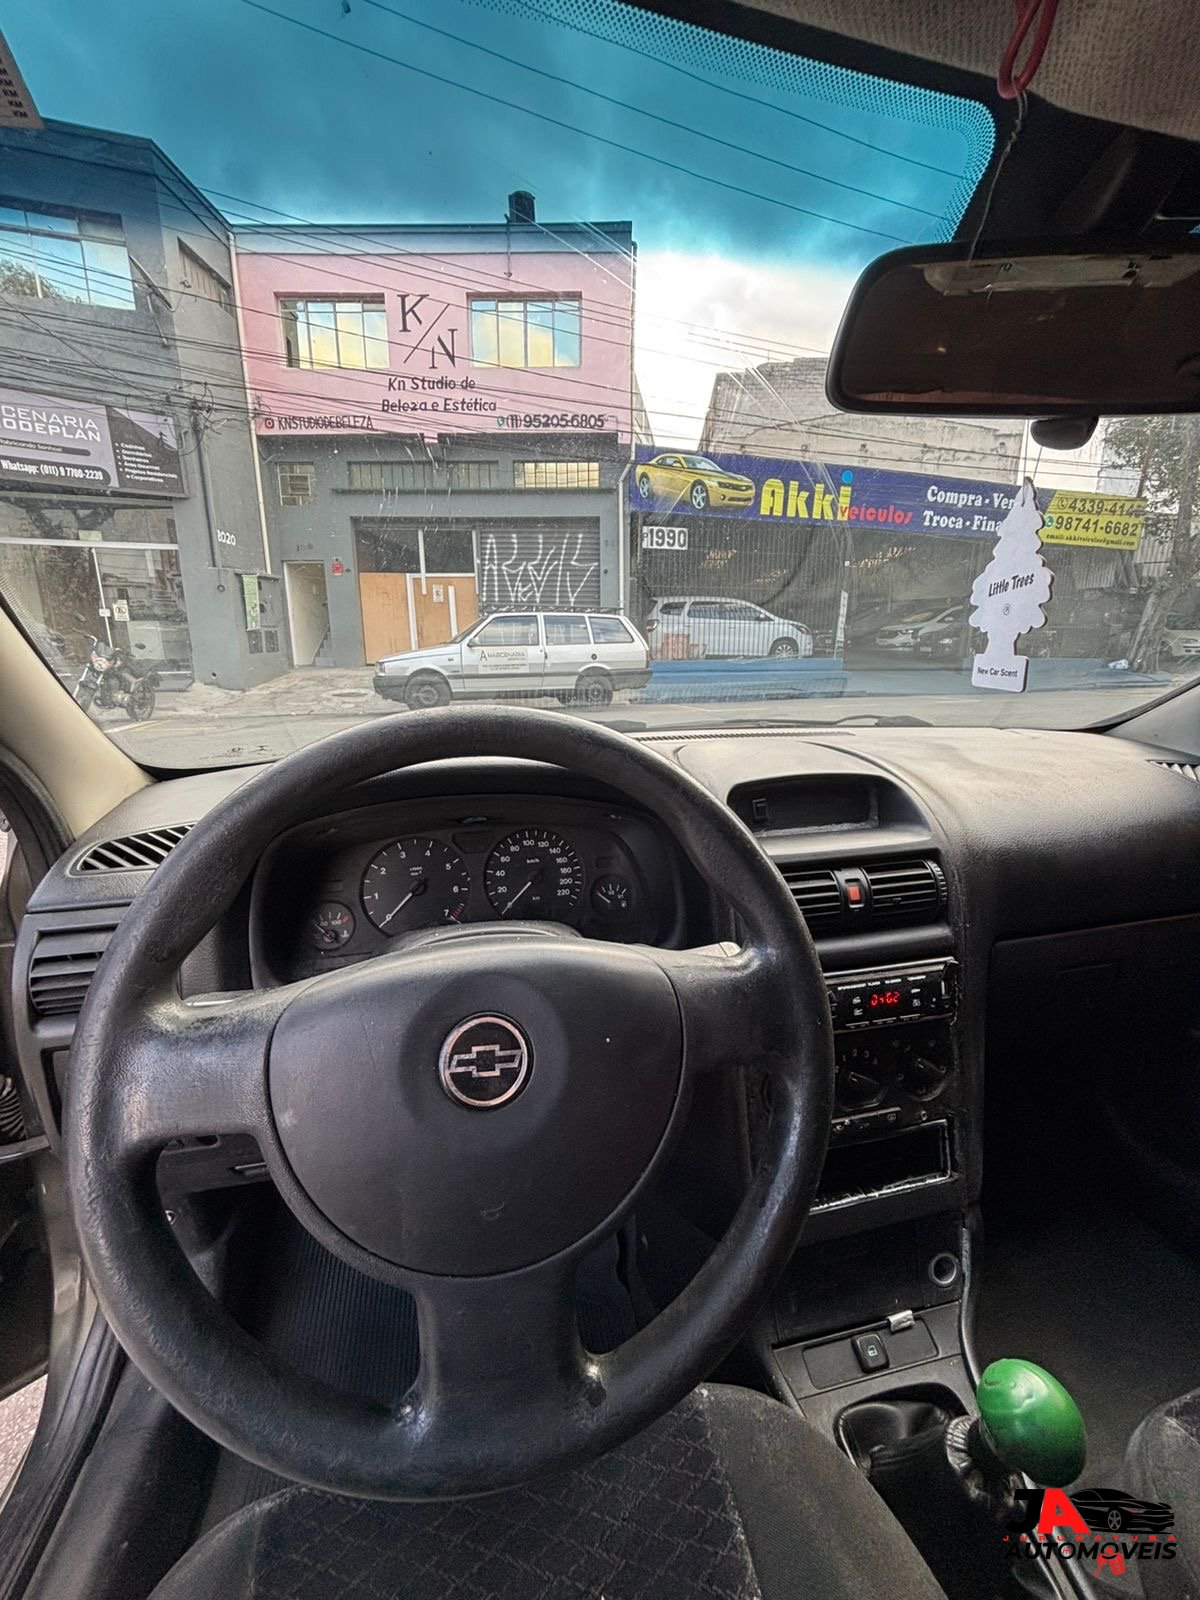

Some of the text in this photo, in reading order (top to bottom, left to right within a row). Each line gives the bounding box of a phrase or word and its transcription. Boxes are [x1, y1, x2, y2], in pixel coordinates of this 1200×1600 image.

[396, 293, 430, 333] K
[429, 328, 458, 369] N
[388, 375, 477, 392] Kn Studio de
[381, 397, 498, 413] Beleza e Estética
[760, 470, 852, 521] Akki
[926, 485, 983, 509] Compra
[923, 510, 963, 529] Troca
[1054, 515, 1139, 537] 98741-6682
[648, 527, 687, 549] 1990
[988, 572, 1035, 597] Little Trees
[977, 666, 1018, 678] New Car Scent
[522, 839, 535, 847] 100
[538, 840, 550, 848] 120
[400, 851, 407, 860] 3
[380, 867, 387, 875] 2
[446, 862, 452, 871] 5
[495, 869, 506, 878] 40
[453, 885, 460, 893] 6
